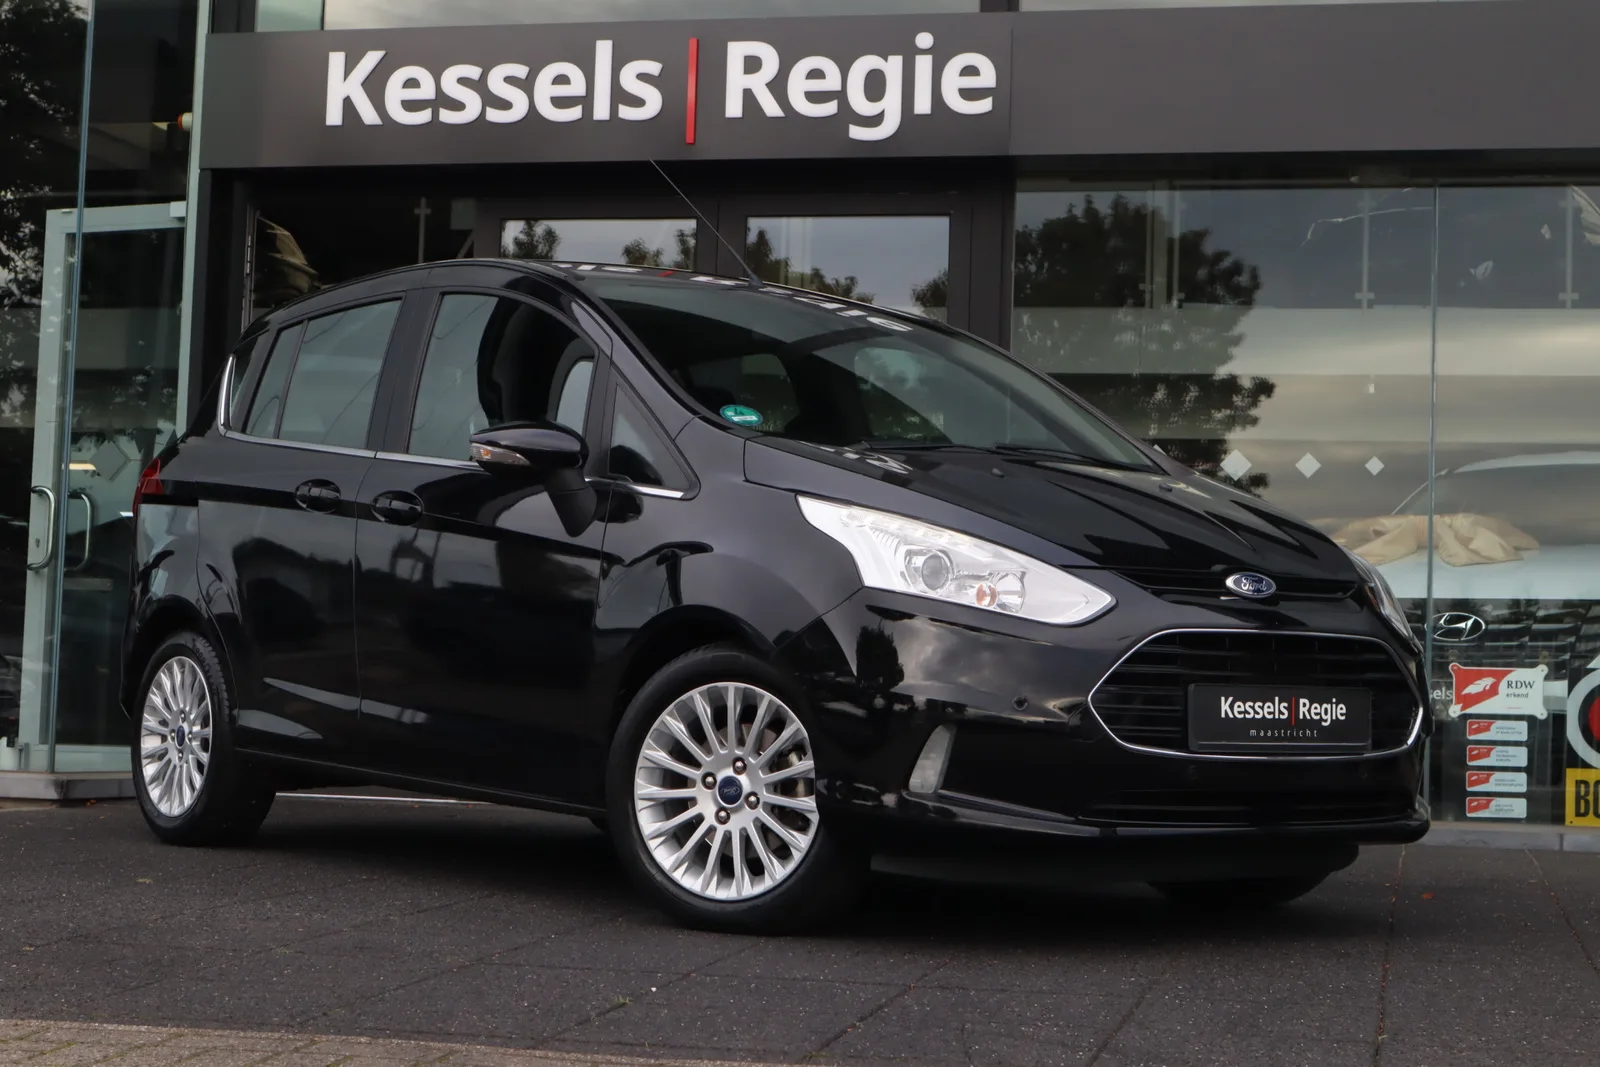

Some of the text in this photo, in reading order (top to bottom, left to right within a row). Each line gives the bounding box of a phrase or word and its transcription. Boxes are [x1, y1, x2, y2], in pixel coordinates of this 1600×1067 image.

[325, 31, 997, 141] Kessels Regie
[1241, 576, 1267, 591] Ford
[1506, 680, 1536, 690] RDW
[1505, 691, 1530, 700] erkend
[1220, 696, 1347, 727] Kessels Regie
[1249, 728, 1318, 738] maastricht
